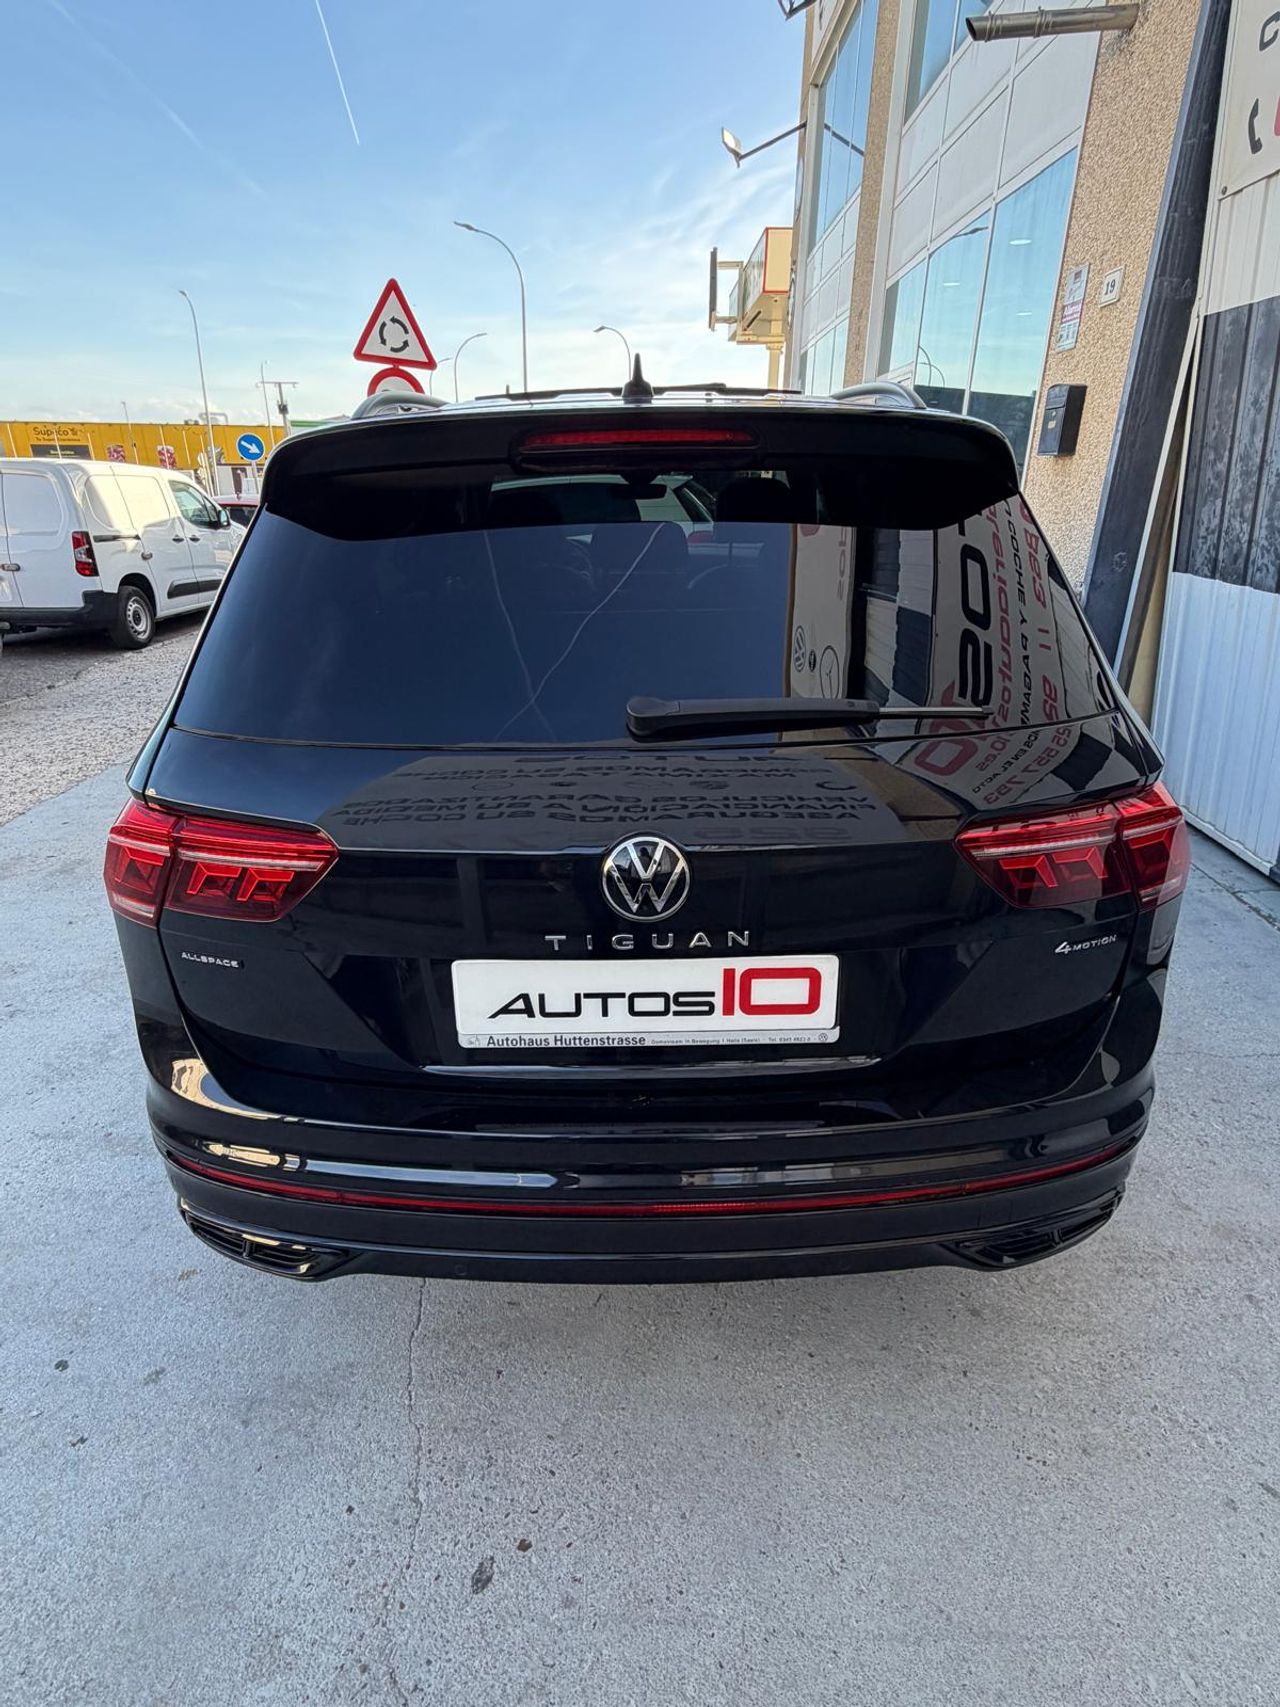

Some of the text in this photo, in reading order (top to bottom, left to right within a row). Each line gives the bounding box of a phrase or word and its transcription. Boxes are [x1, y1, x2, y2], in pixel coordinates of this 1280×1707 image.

[1104, 279, 1116, 296] 19
[544, 931, 750, 951] TIGUAN
[181, 952, 239, 968] ALLSPACE
[487, 967, 822, 1019] AUTOS10
[486, 1035, 550, 1047] Autohaus
[553, 1034, 646, 1047] Huttenstrasse
